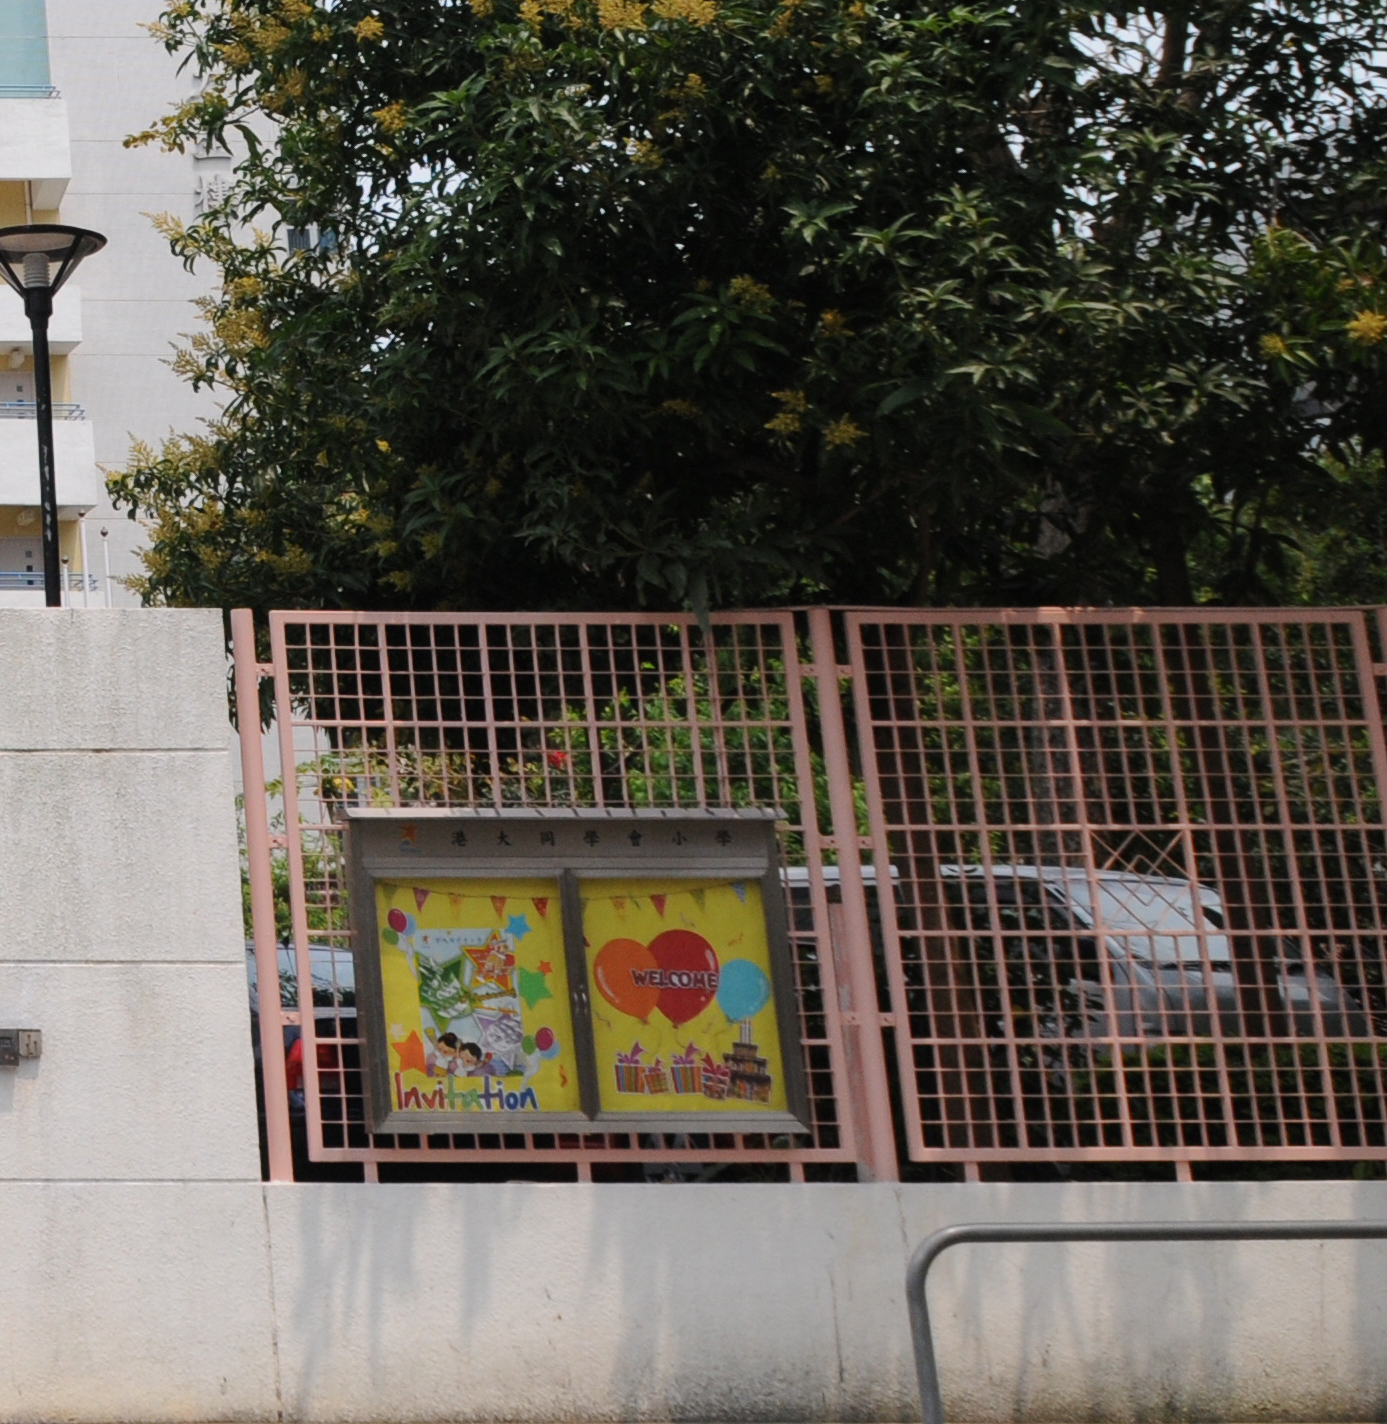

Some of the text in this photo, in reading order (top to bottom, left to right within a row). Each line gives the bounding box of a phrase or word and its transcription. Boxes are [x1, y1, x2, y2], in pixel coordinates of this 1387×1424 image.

[451, 829, 732, 848] 港大同學會小學
[631, 968, 719, 989] WELCOME
[394, 1071, 539, 1111] Invitation
